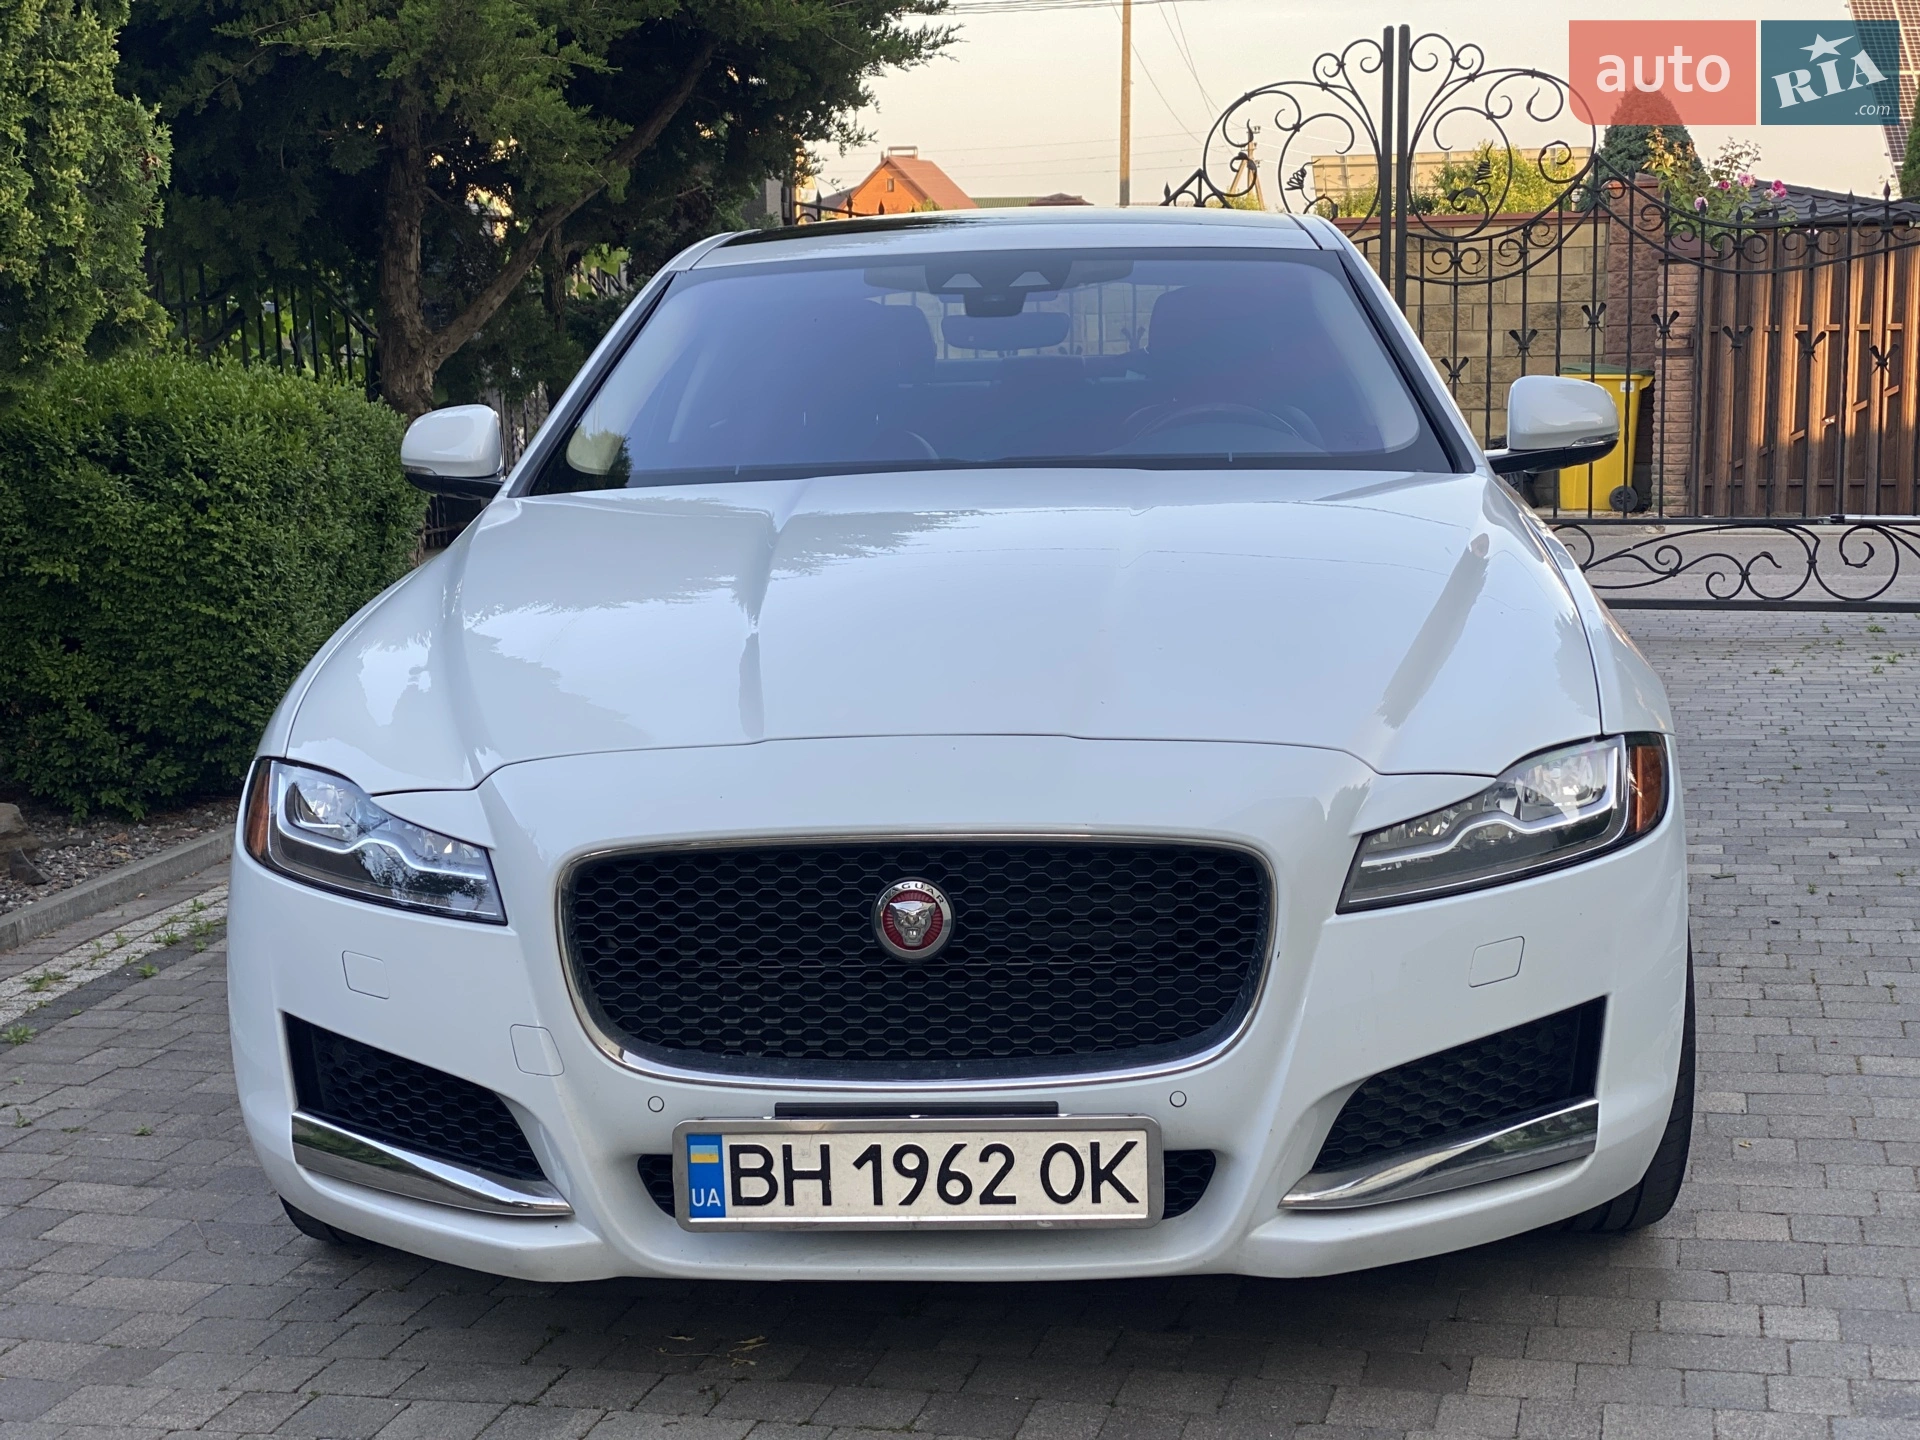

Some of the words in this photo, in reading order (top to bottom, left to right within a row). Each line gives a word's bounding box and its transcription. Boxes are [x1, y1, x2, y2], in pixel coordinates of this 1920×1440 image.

[728, 1143, 833, 1207] BH
[852, 1143, 1017, 1206] 1962
[1039, 1140, 1141, 1205] OK
[692, 1188, 722, 1207] UA
